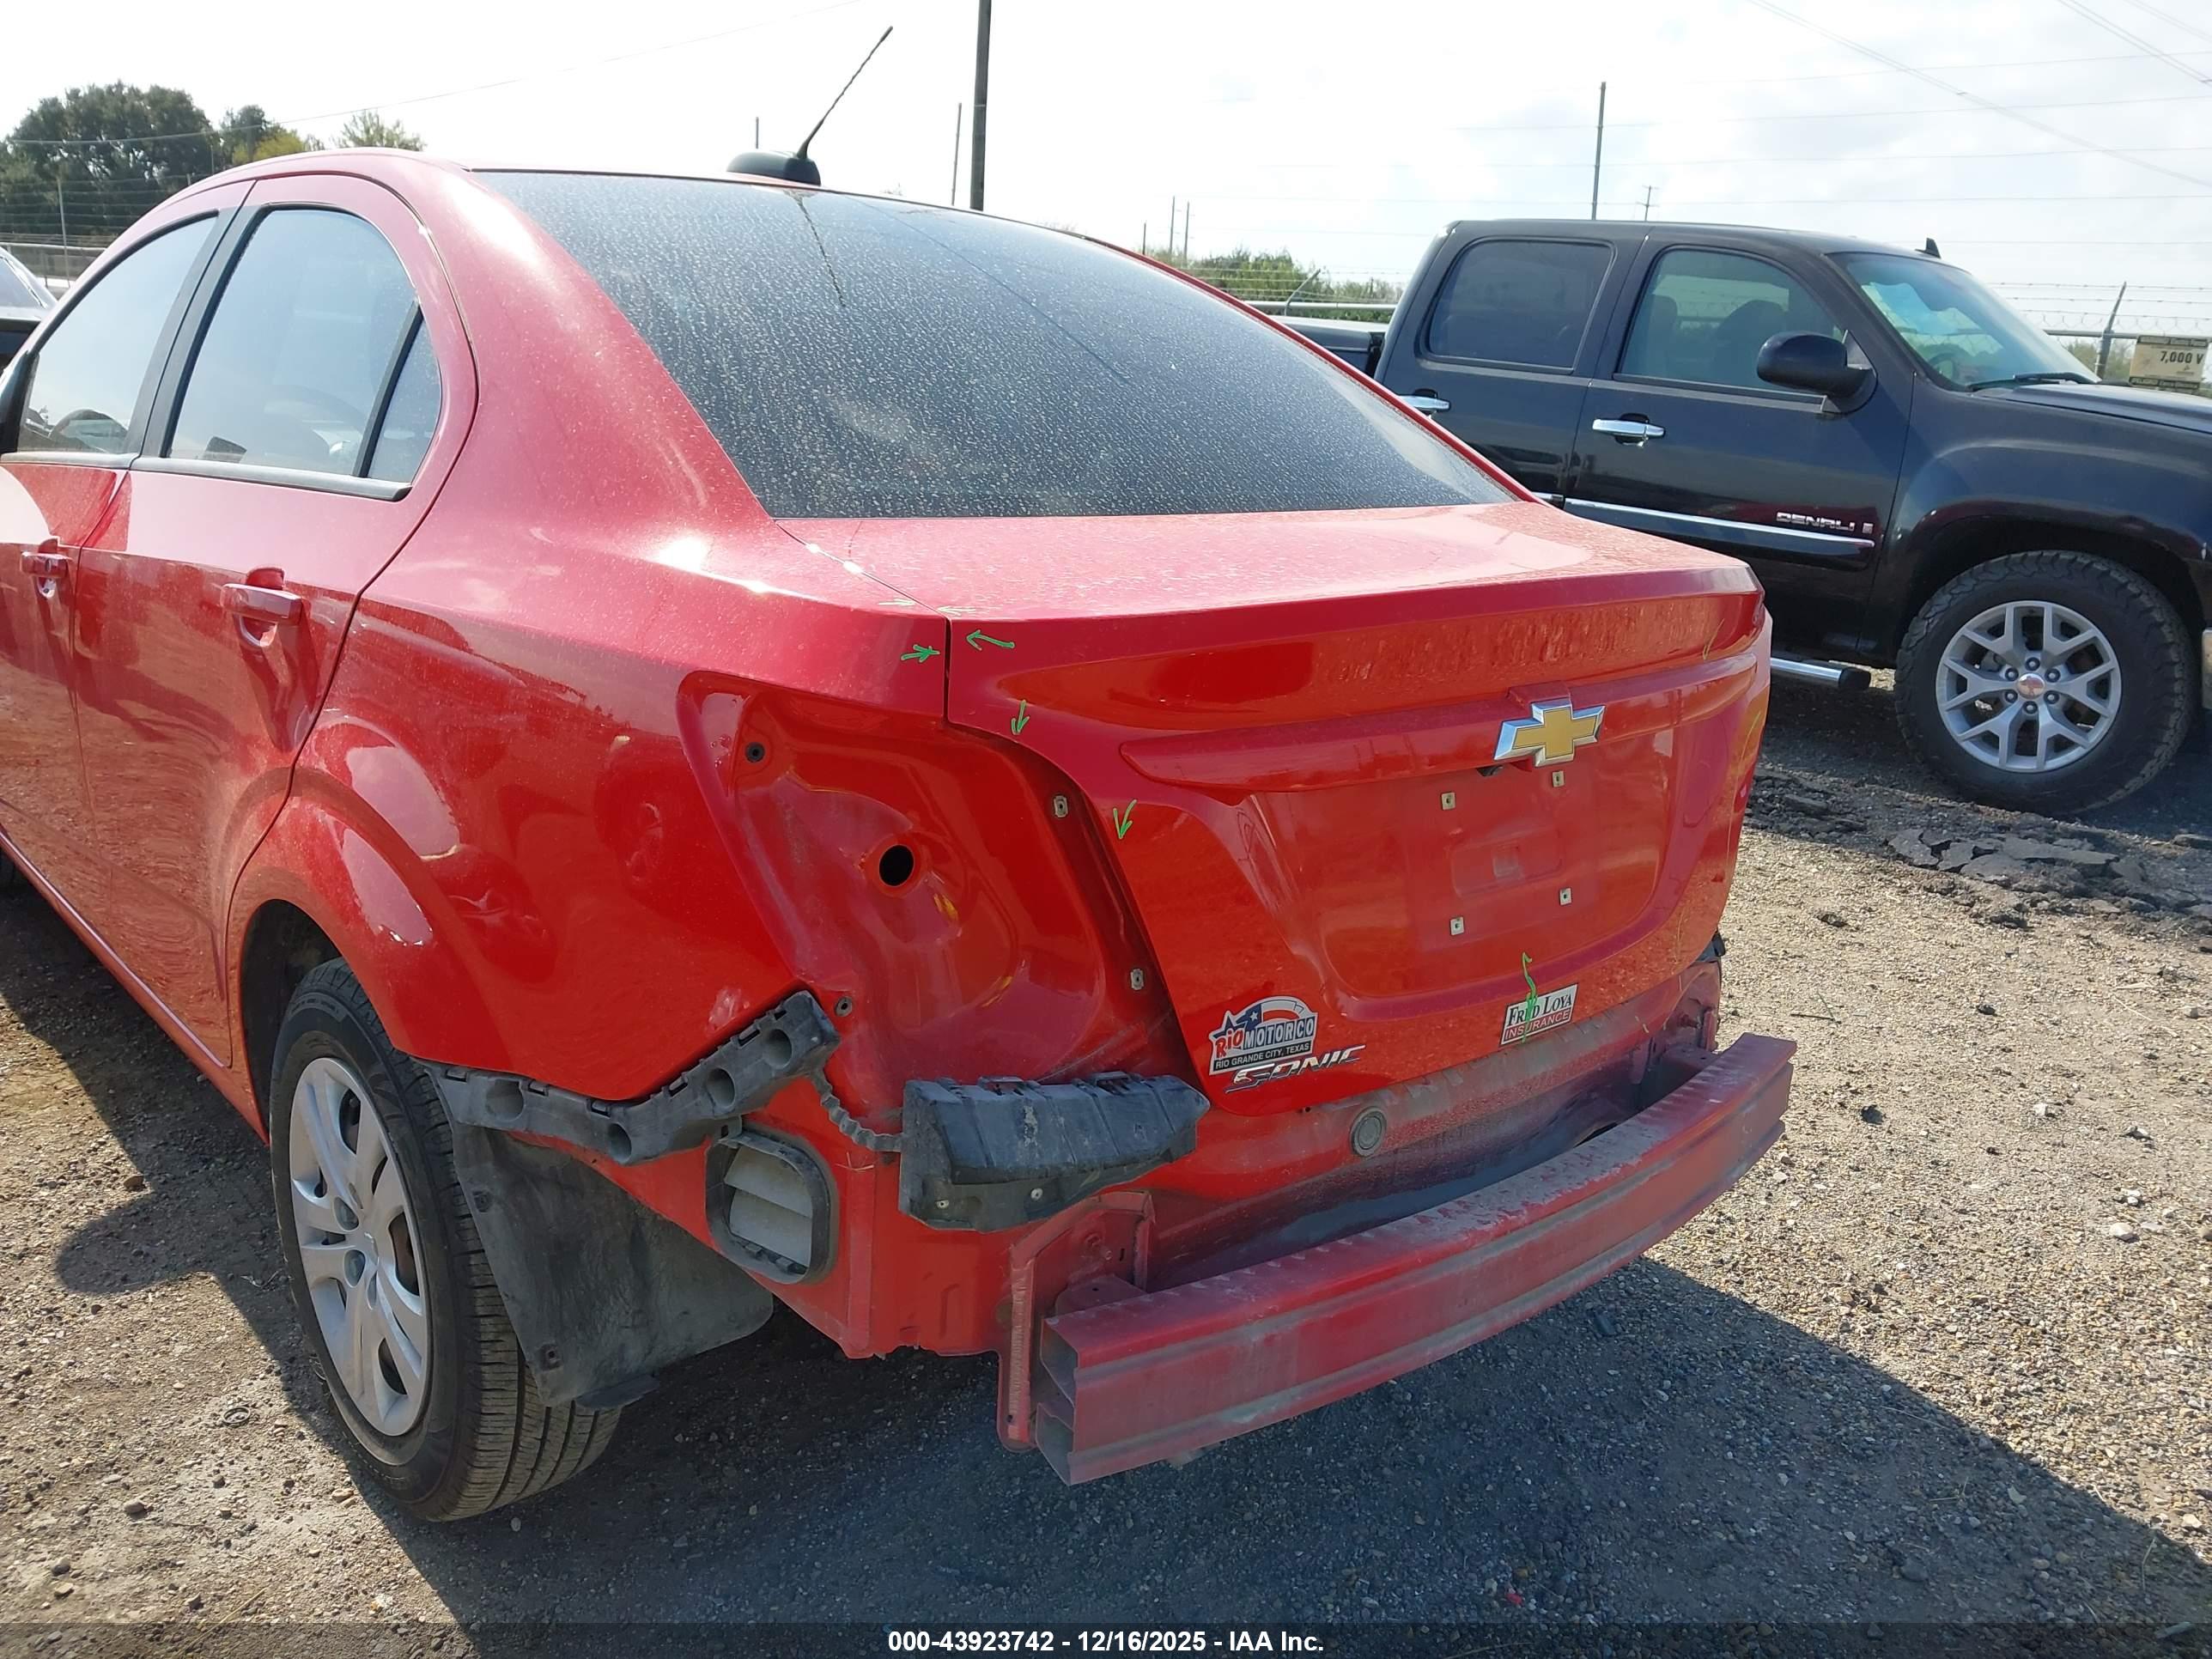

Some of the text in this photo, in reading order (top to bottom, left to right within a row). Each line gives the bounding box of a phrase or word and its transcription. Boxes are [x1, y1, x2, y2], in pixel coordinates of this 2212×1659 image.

[2160, 350, 2204, 364] 7,000 V
[1776, 512, 1855, 532] DENALI
[1507, 1005, 1540, 1027] FRD
[1215, 1042, 1310, 1070] RIO GRANDE CITY, TEXAS
[1225, 1045, 1366, 1093] SONIC
